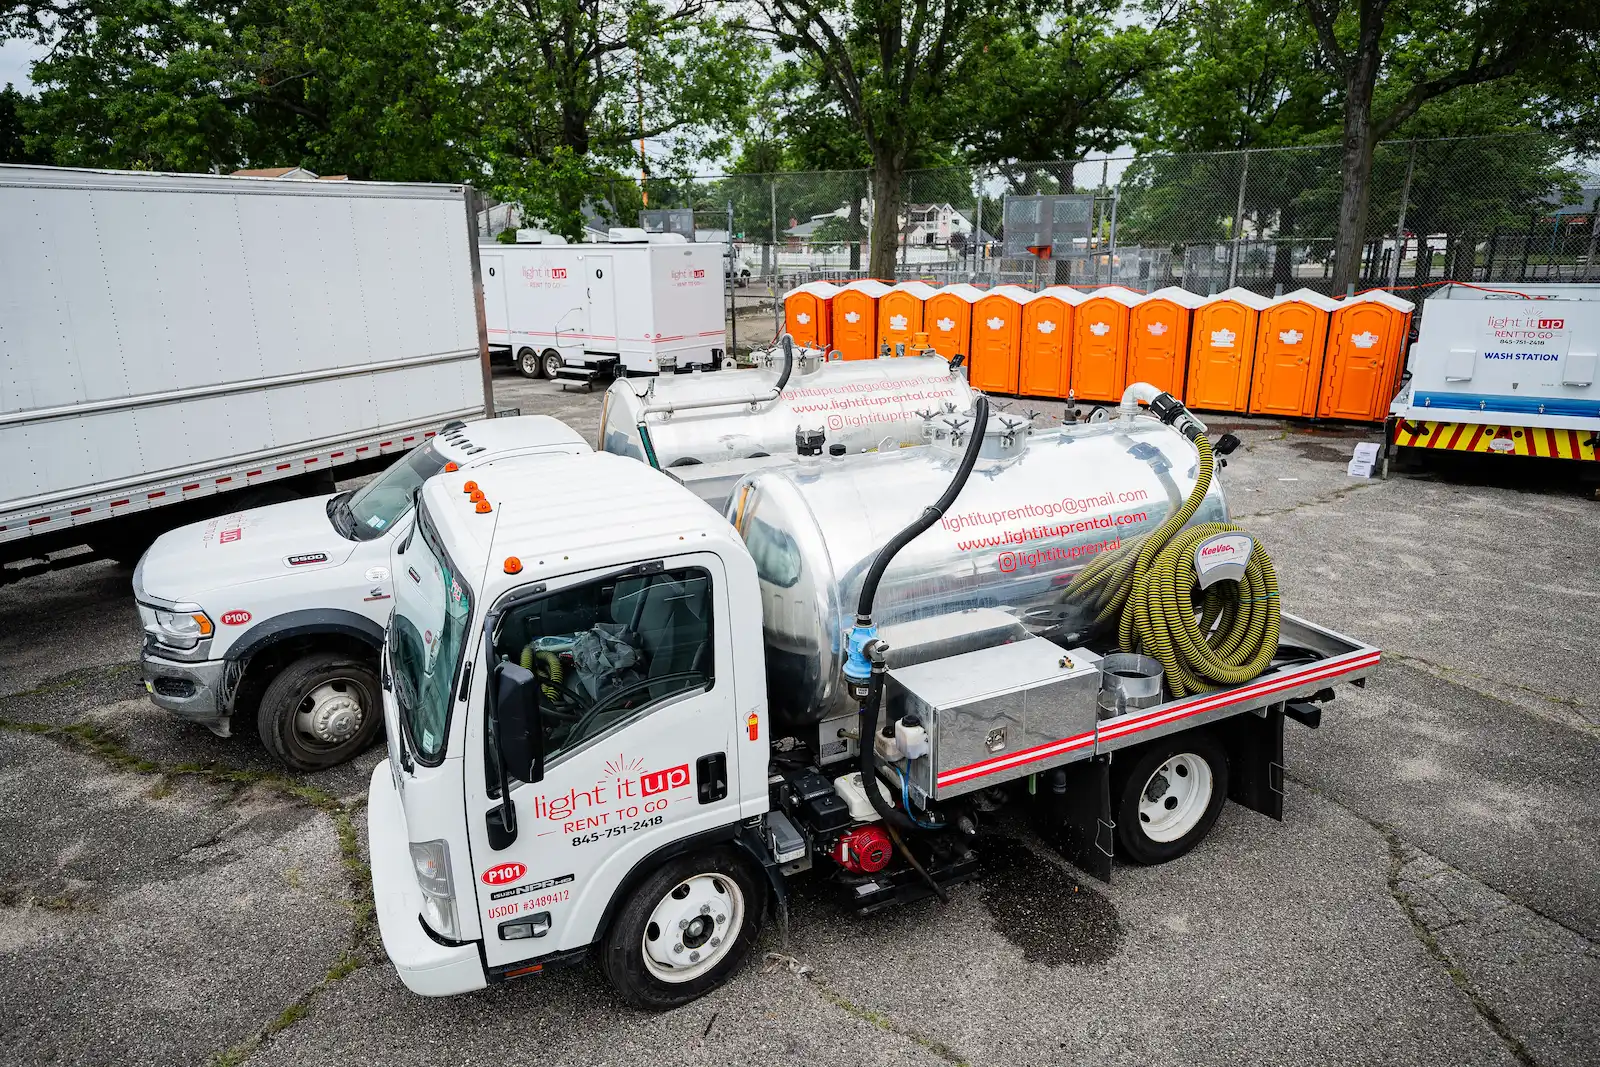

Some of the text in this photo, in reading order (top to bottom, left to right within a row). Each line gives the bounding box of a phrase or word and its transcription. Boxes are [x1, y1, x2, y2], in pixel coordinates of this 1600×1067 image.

[552, 269, 566, 279] up
[694, 270, 704, 278] up
[1487, 316, 1564, 329] light it up
[1494, 330, 1553, 339] RENT TO GO
[1484, 352, 1559, 361] WASH STATION
[792, 387, 954, 414] www.lightituprental.com
[941, 487, 1149, 533] lightituprenttogo@gmail.com
[957, 511, 1148, 551] www.lightituprental.com
[291, 554, 324, 562] 5500
[1018, 536, 1122, 569] lightituprental
[1202, 544, 1233, 556] KeeVac
[224, 612, 249, 623] P100
[534, 765, 689, 821] light it up
[564, 798, 669, 834] RENT TO GO
[571, 815, 664, 847] 845-751-2418
[488, 865, 521, 883] P101
[493, 891, 516, 900] ISUZU
[516, 880, 555, 895] NPR
[488, 889, 570, 919] USDOT #3489412
